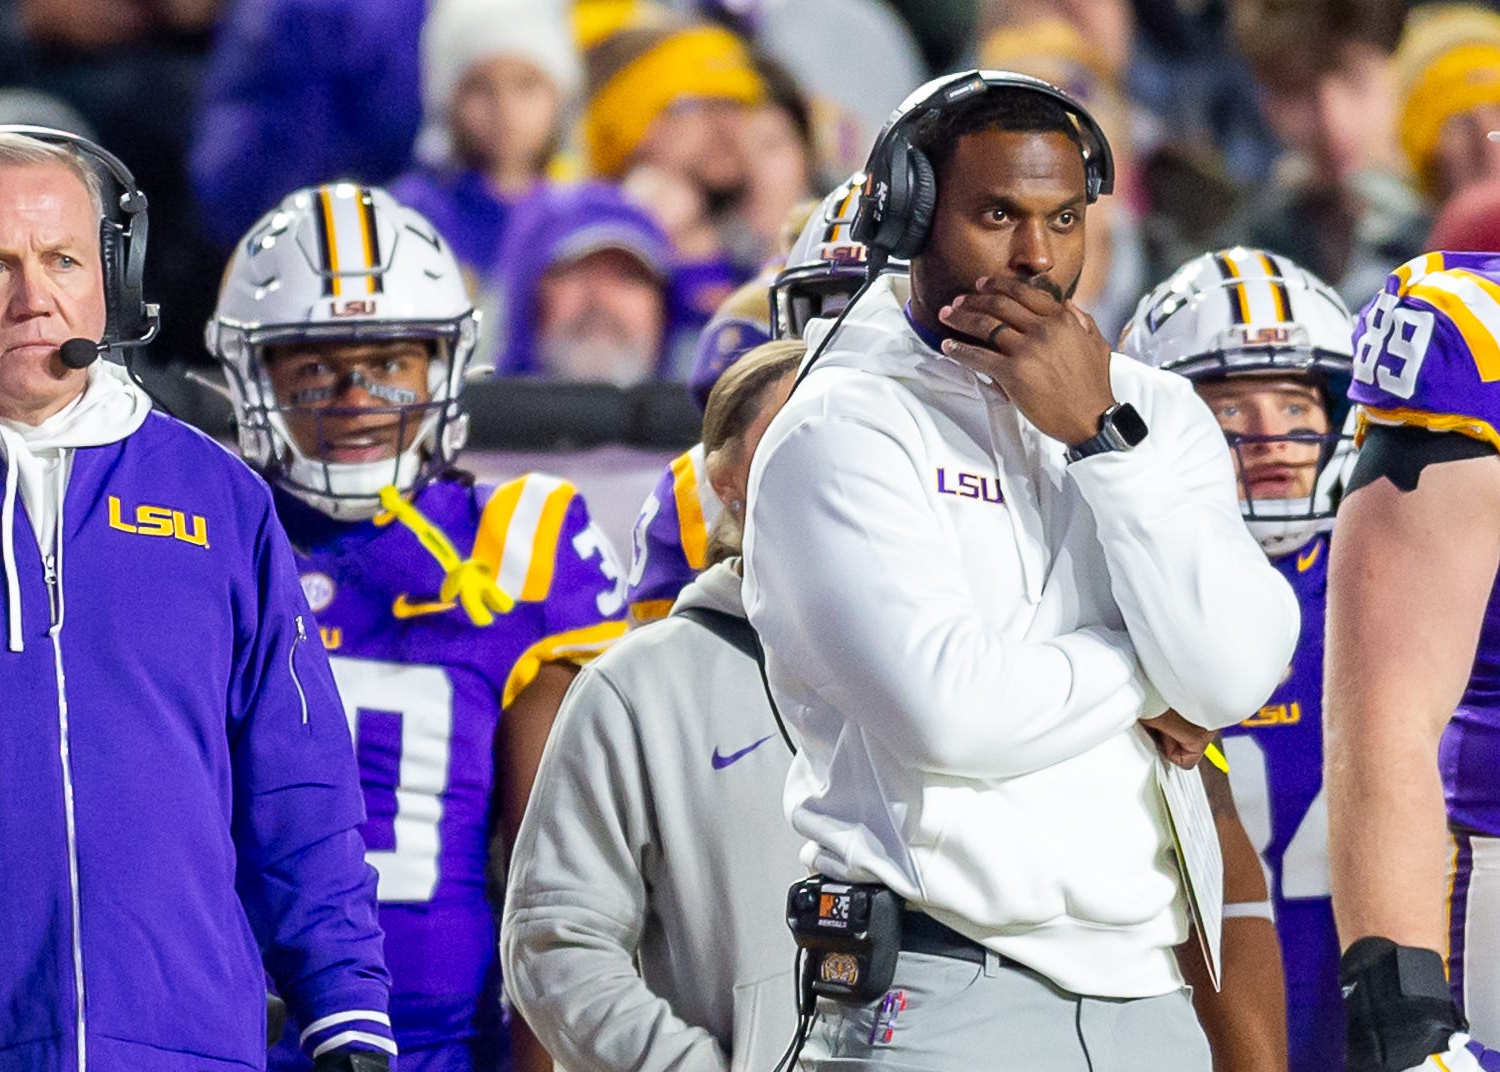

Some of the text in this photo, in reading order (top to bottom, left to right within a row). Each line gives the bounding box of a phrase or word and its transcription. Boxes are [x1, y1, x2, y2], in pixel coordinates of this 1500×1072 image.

[330, 300, 376, 317] LSU
[1242, 328, 1289, 345] LSU
[1352, 291, 1435, 400] 89
[935, 467, 1005, 504] LSU
[107, 495, 207, 547] LSU
